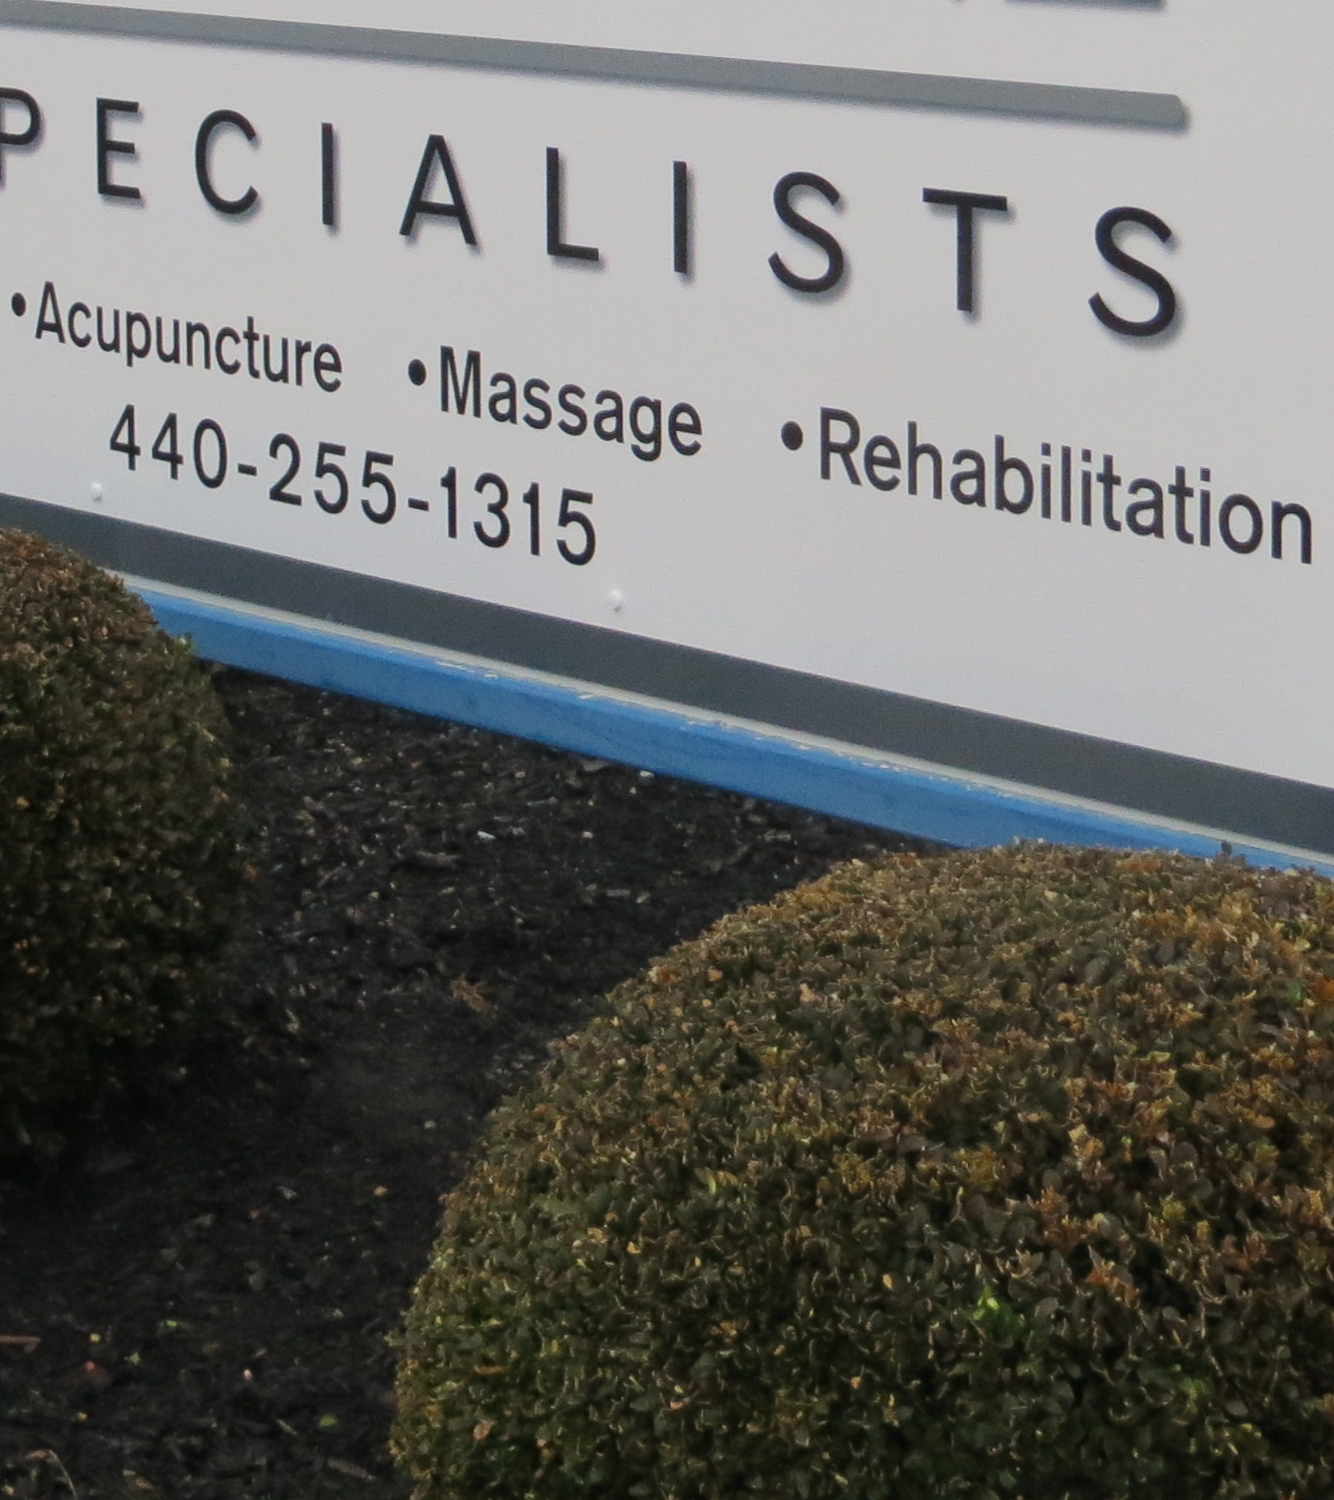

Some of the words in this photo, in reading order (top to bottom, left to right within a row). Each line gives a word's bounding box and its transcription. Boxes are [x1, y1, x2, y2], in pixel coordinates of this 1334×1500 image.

[34, 280, 344, 394] Acupuncture
[438, 345, 704, 462] Massage
[819, 405, 1315, 566] Rehabilitation
[109, 404, 598, 567] 440-255-1315
